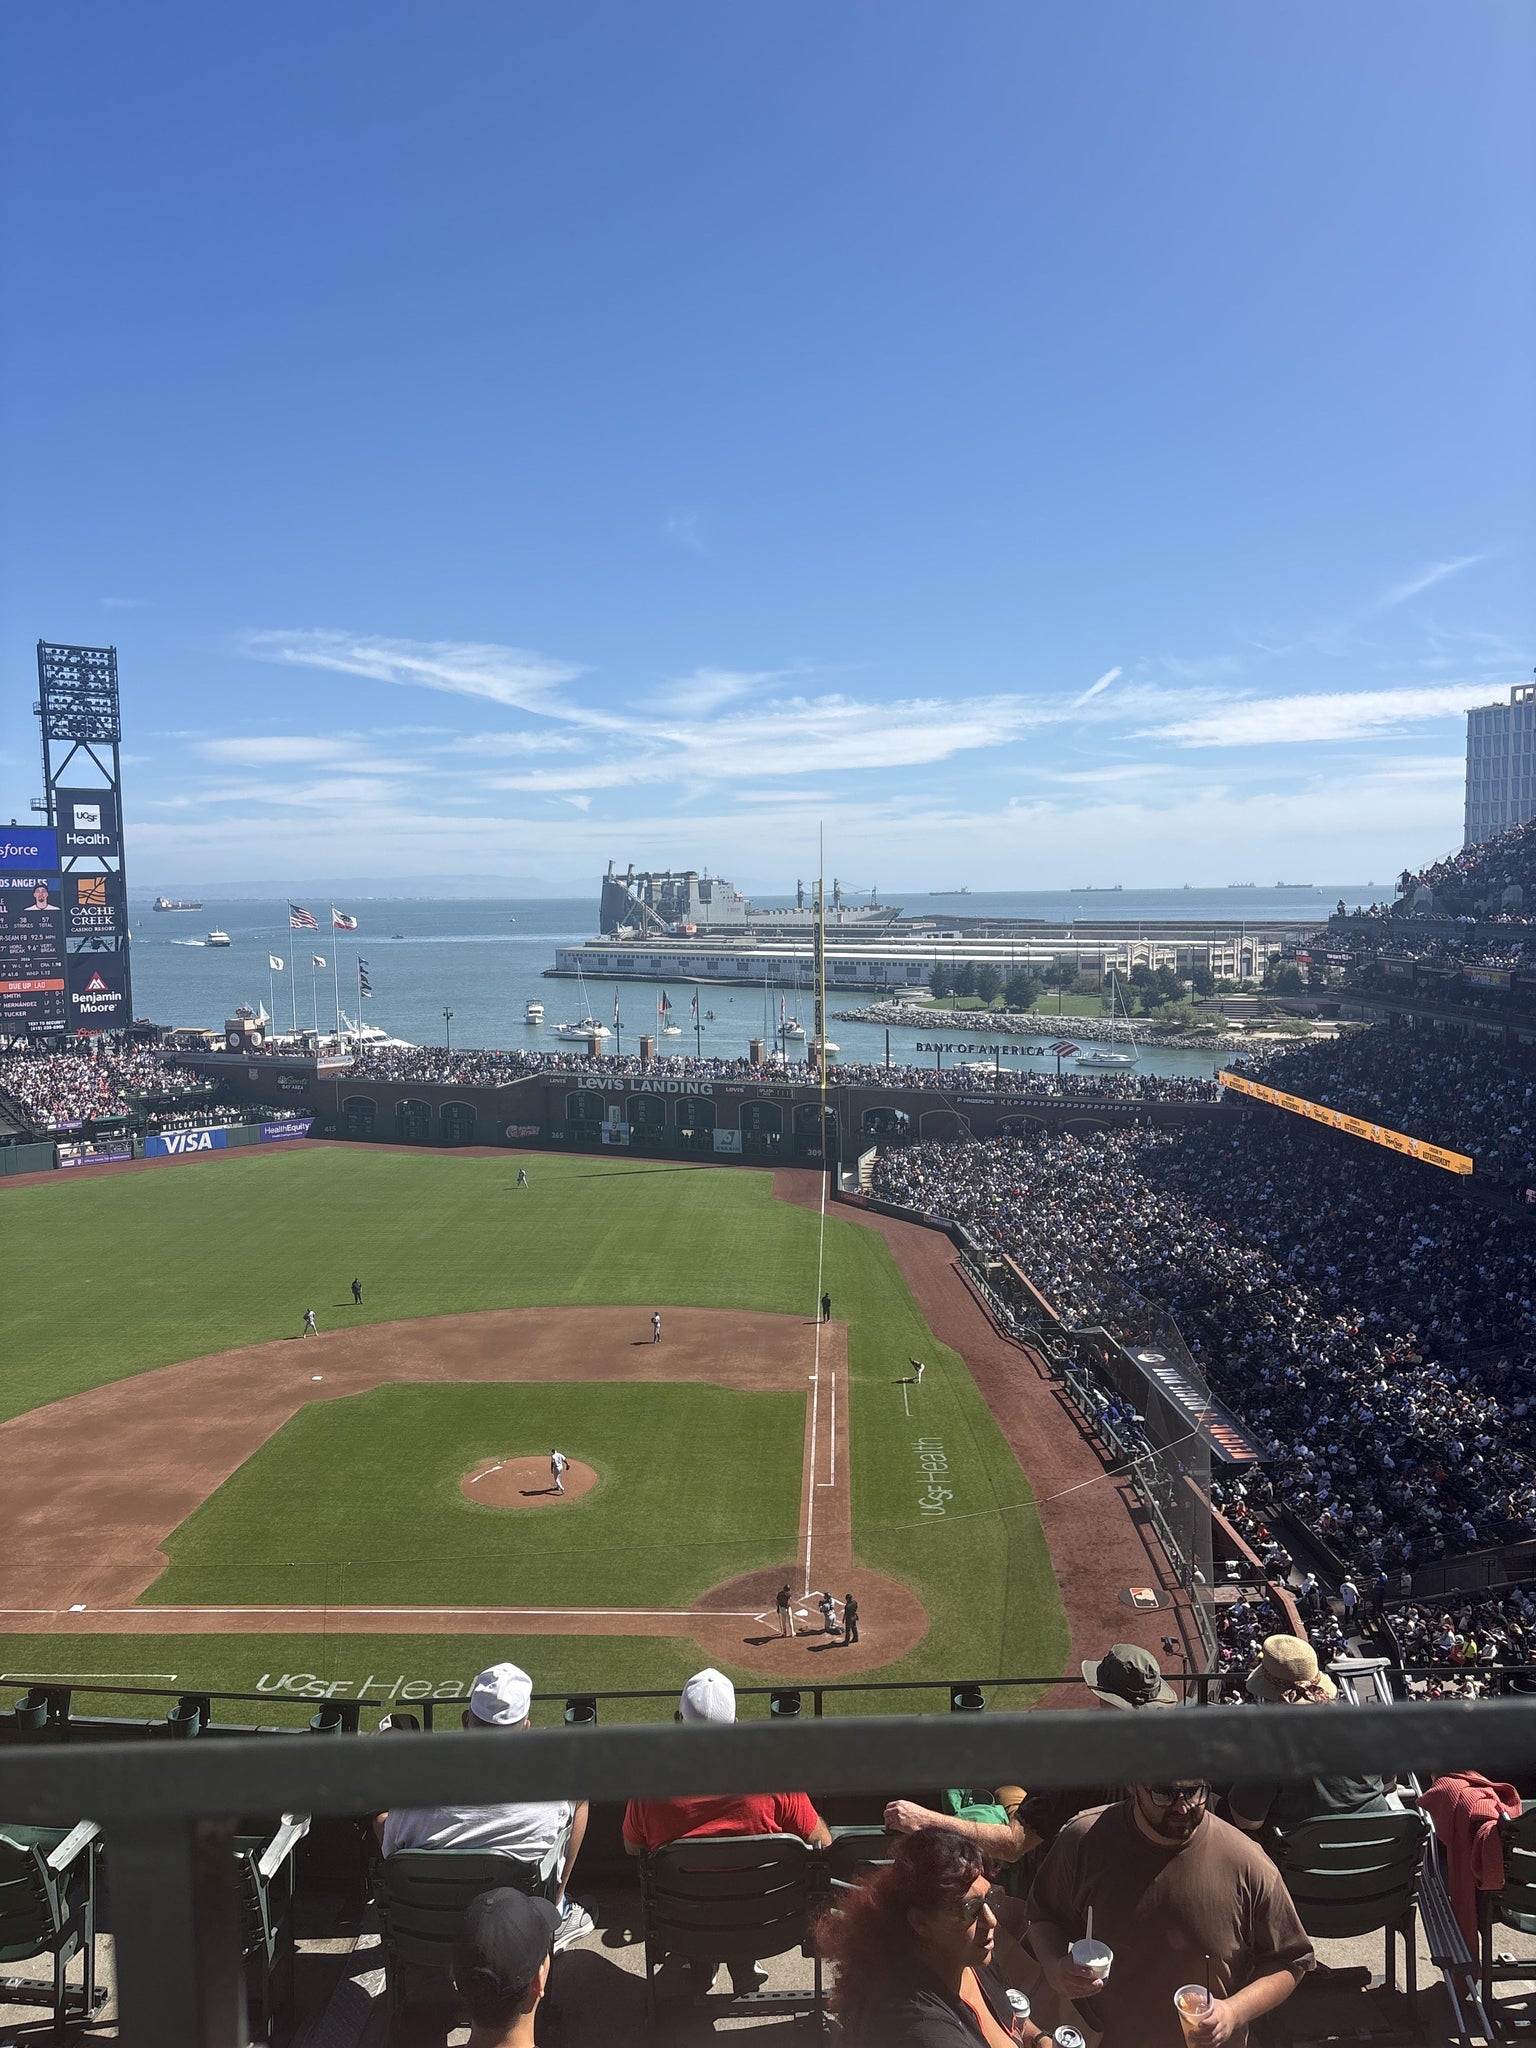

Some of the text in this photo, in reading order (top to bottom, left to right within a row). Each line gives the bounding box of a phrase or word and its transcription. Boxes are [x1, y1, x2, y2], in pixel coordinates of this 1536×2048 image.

[76, 811, 98, 823] UCSF
[66, 833, 110, 845] Health
[70, 906, 115, 916] CACHE
[71, 916, 114, 925] CREEK
[8, 982, 22, 990] DUE
[33, 981, 46, 989] LAD
[72, 991, 122, 1004] Benjamin
[916, 1042, 1045, 1056] BANK OF AMERICA
[630, 1079, 713, 1095] LANDING
[162, 1121, 198, 1130] WELCOME
[264, 1123, 311, 1135] HealthEquity
[160, 1132, 214, 1154] VISA
[807, 1148, 822, 1157] 309
[911, 1437, 954, 1516] UCSF Health
[255, 1673, 354, 1699] UCSF
